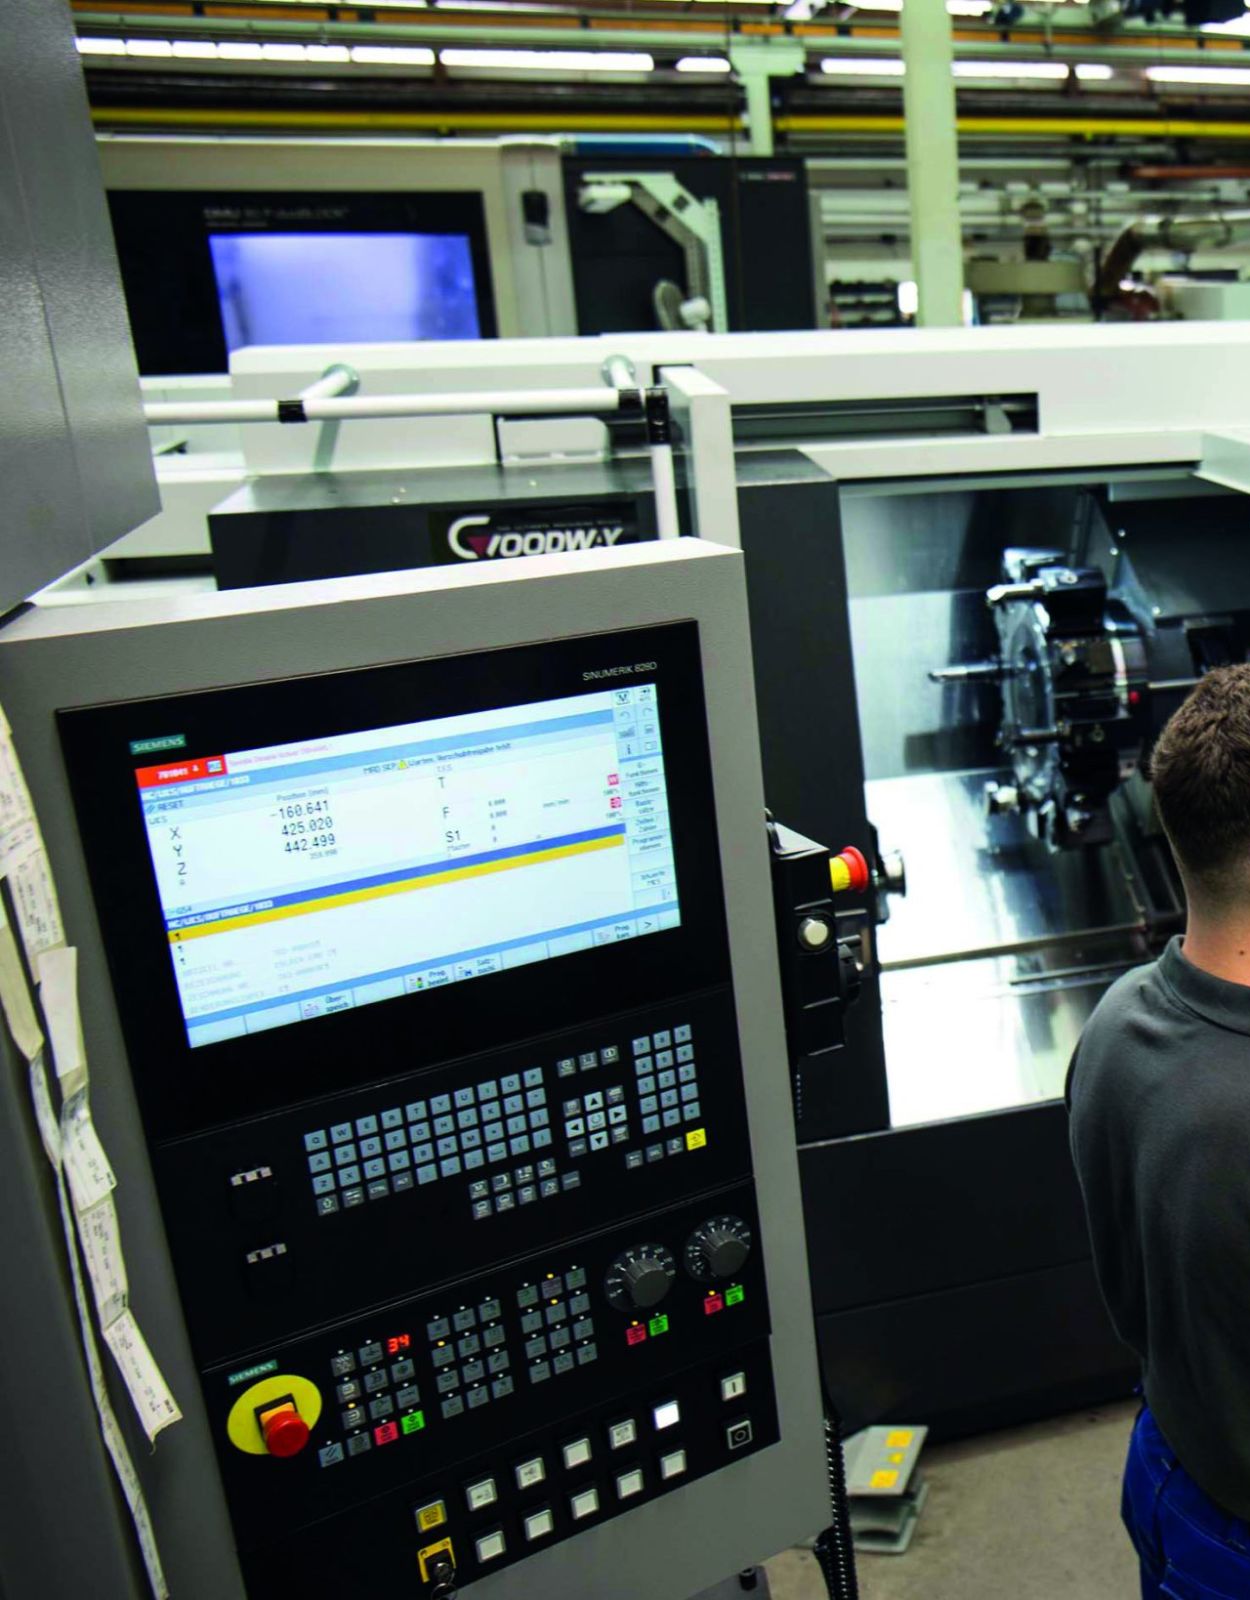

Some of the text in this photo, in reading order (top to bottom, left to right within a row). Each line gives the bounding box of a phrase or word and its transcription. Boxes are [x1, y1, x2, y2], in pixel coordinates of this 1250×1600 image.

[583, 665, 633, 681] SINUMERIK
[133, 737, 184, 752] SIEMENS
[437, 776, 445, 789] T
[158, 800, 184, 811] RESET
[270, 799, 329, 820] -160.641
[442, 806, 450, 820] F
[170, 826, 181, 841] X
[282, 816, 333, 836] 425.020
[285, 832, 336, 853] 442.499
[445, 829, 461, 843] S1
[173, 843, 182, 857] Y
[177, 861, 187, 876] Z
[387, 1334, 411, 1355] 34
[229, 1361, 275, 1385] SIEMENS
